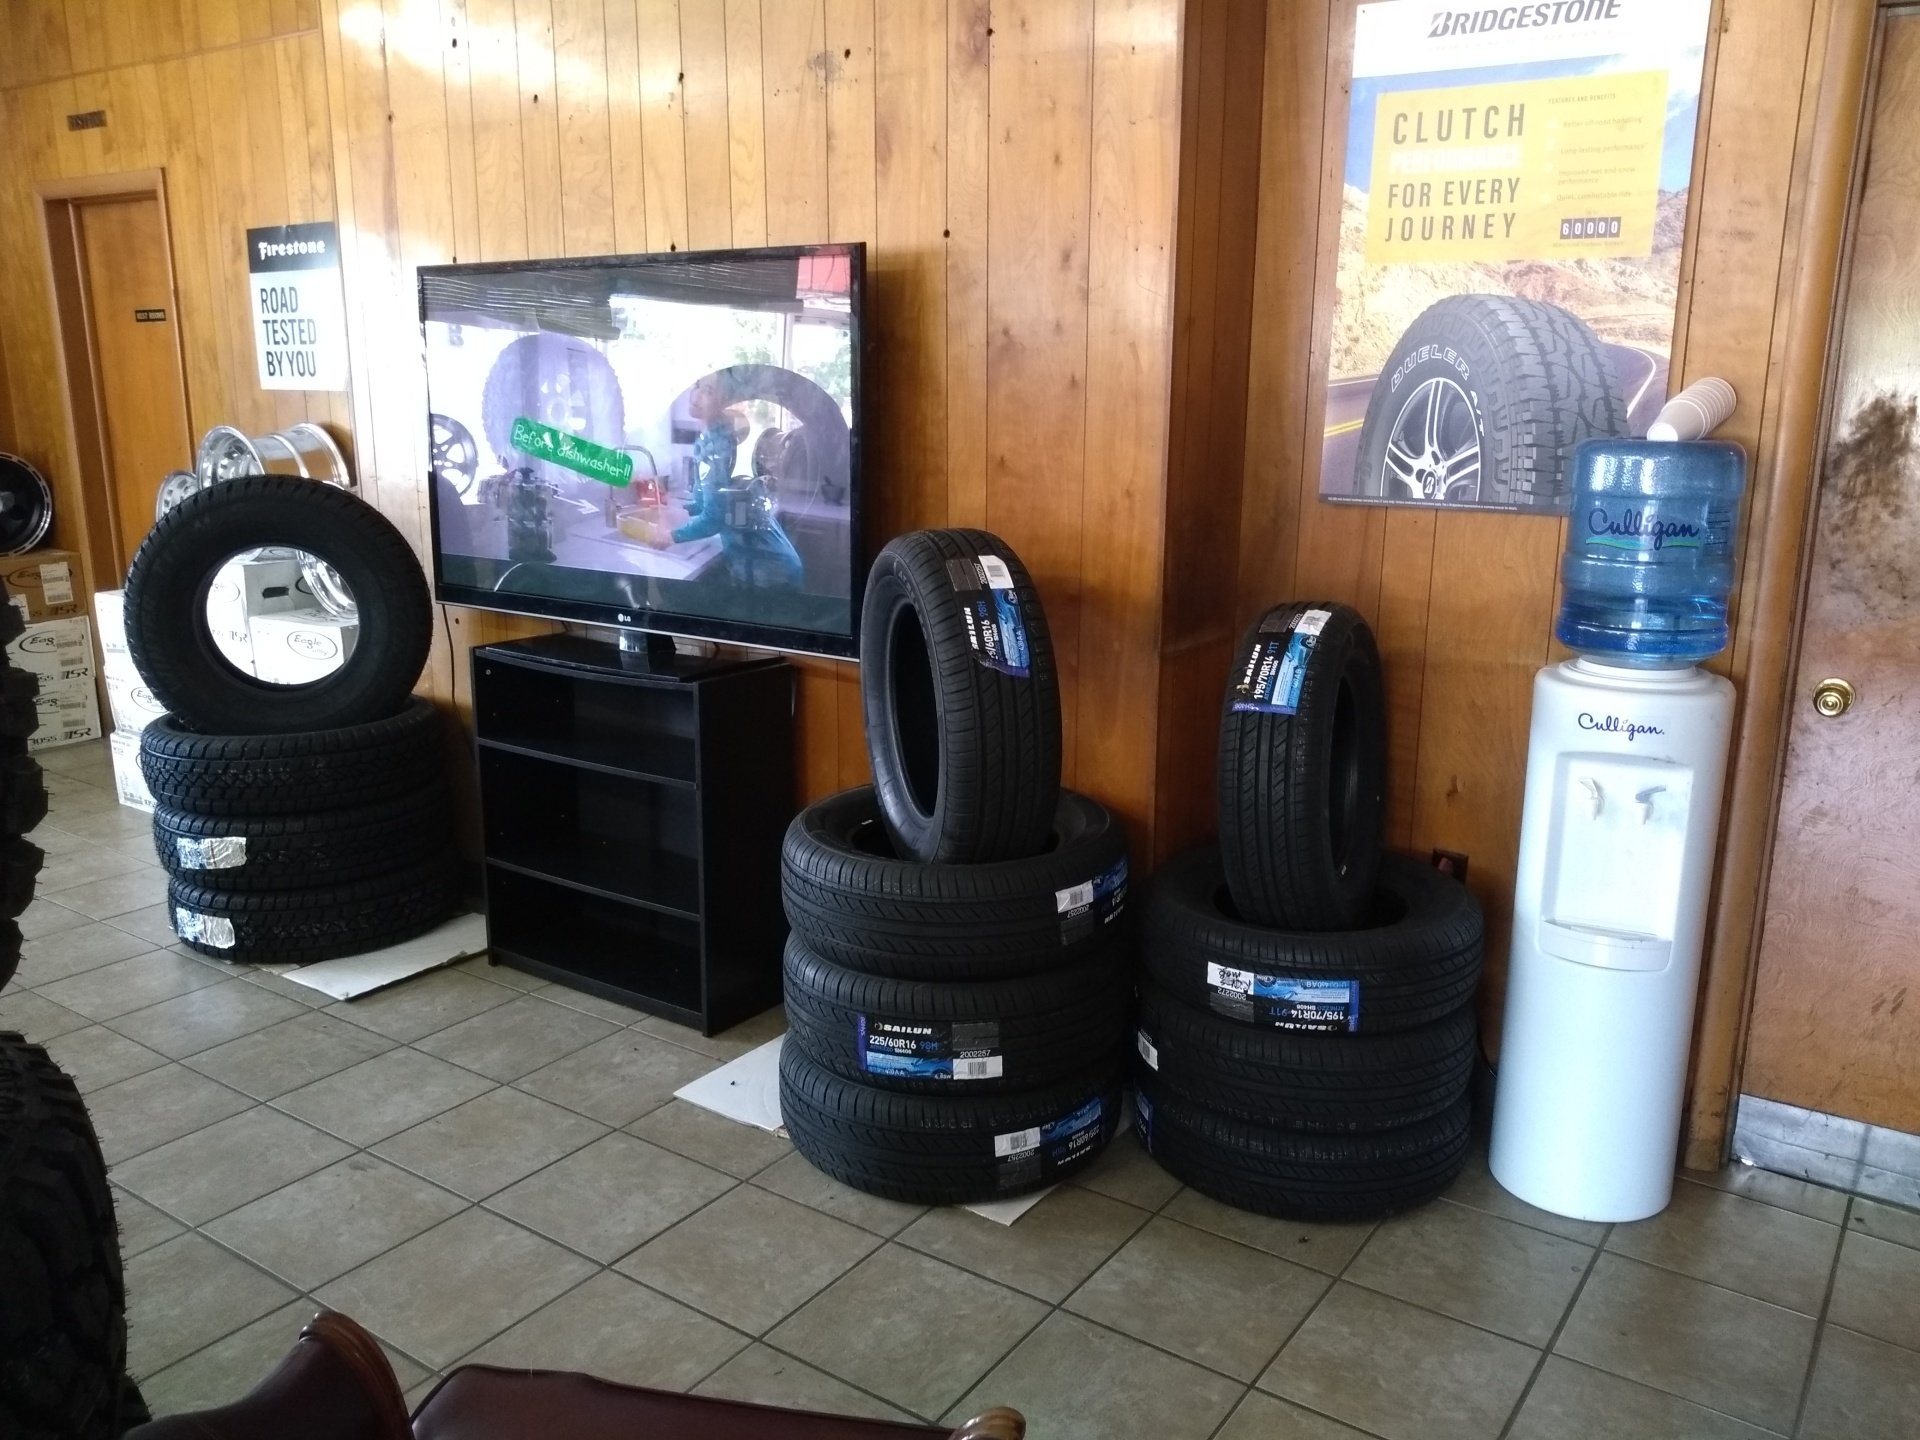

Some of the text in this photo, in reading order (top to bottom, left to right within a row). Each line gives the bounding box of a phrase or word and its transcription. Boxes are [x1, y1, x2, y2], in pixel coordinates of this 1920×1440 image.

[1427, 0, 1622, 38] BRIDGESTONE
[1577, 94, 1588, 103] AND
[1589, 92, 1616, 102] BENEFITS
[1392, 103, 1525, 145] CLUTCH
[1387, 177, 1521, 209] FOR EVERY
[1384, 212, 1517, 242] JOURNEY
[1562, 220, 1619, 236] 60000
[257, 240, 326, 261] Firestone
[260, 286, 299, 314] ROAD
[262, 318, 317, 346] TESTED
[266, 350, 317, 377] BY YOU
[1391, 344, 1470, 393] DUELER
[1588, 507, 1700, 551] Culligan
[294, 634, 322, 650] Eagle
[1243, 643, 1262, 685] SAILUN
[1253, 655, 1275, 700] 195/70R14
[1217, 987, 1247, 1001] 2002272
[1291, 1009, 1344, 1021] 195/70R14
[869, 1035, 917, 1050] 225/60R16
[883, 1023, 933, 1035] SAILUN
[959, 1049, 991, 1059] 2002257
